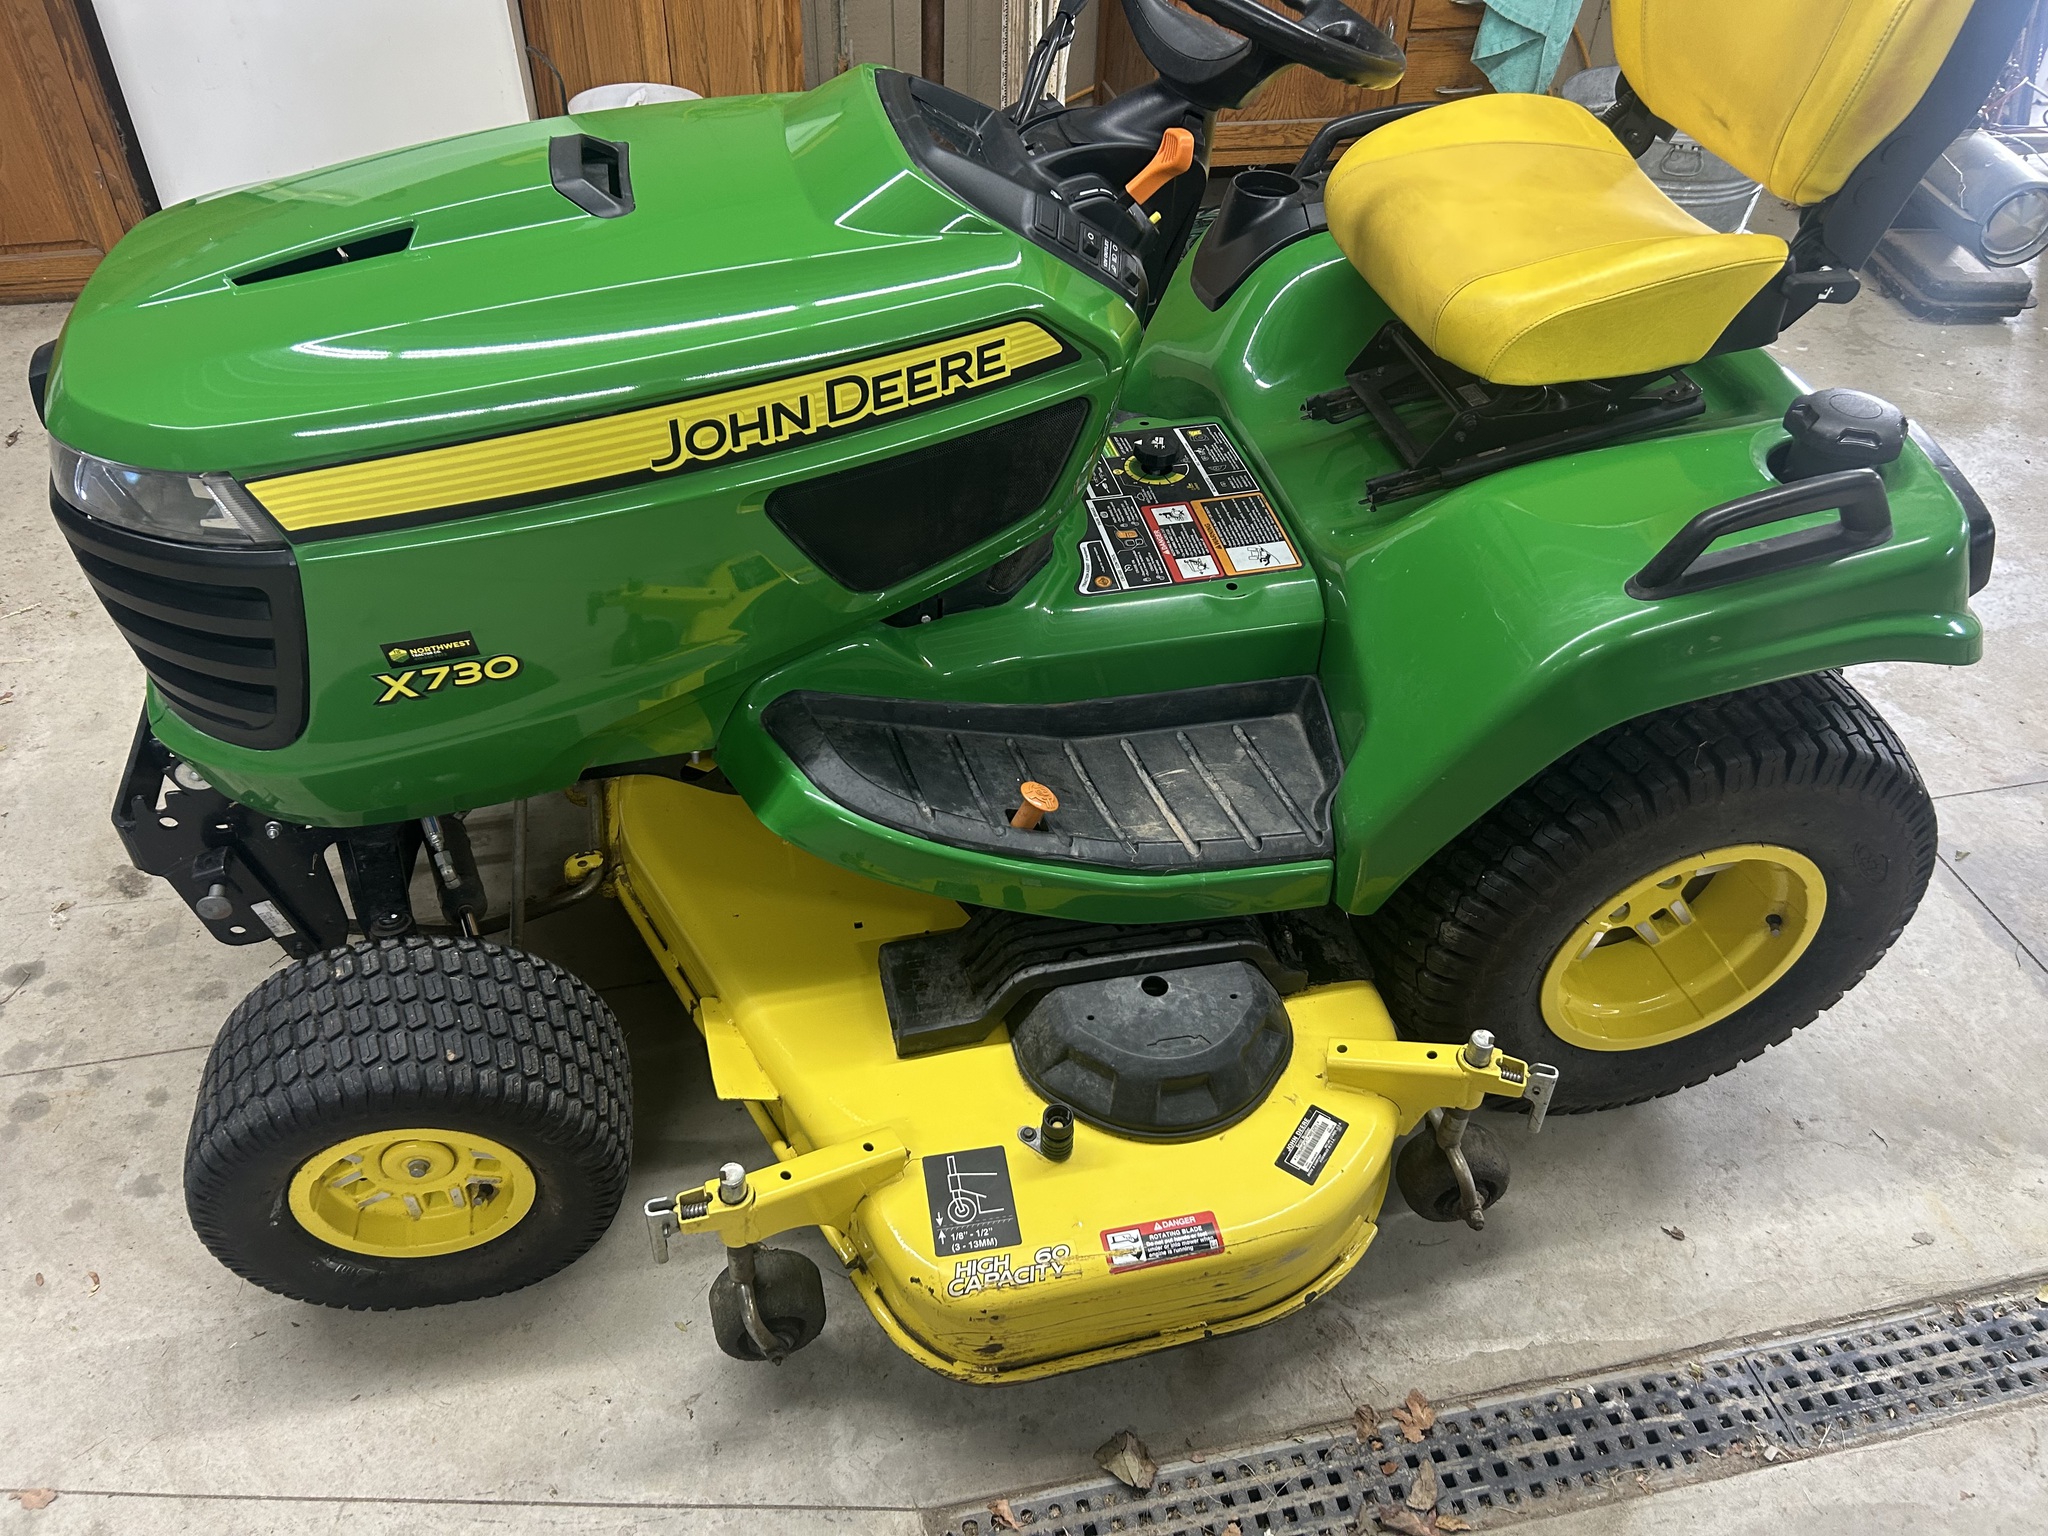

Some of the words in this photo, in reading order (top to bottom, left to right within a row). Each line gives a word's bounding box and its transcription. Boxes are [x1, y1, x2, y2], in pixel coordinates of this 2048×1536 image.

[651, 394, 811, 468] JOHN
[825, 337, 1008, 423] DEERE
[1152, 529, 1167, 550] DANGER
[1203, 522, 1219, 544] WARNING
[410, 640, 471, 654] NORTHWEST
[374, 655, 521, 704] X730
[1162, 1216, 1196, 1228] DANGER
[950, 1231, 968, 1242] 1/8"
[976, 1227, 993, 1238] 1/2"
[1149, 1230, 1180, 1240] ROTATING
[1182, 1226, 1202, 1234] BLADE
[951, 1243, 960, 1253] (3
[968, 1237, 998, 1250] 13MM)
[955, 1253, 1010, 1279] HIGH
[1034, 1244, 1071, 1265] 60
[947, 1261, 1065, 1297] CAPACITY
